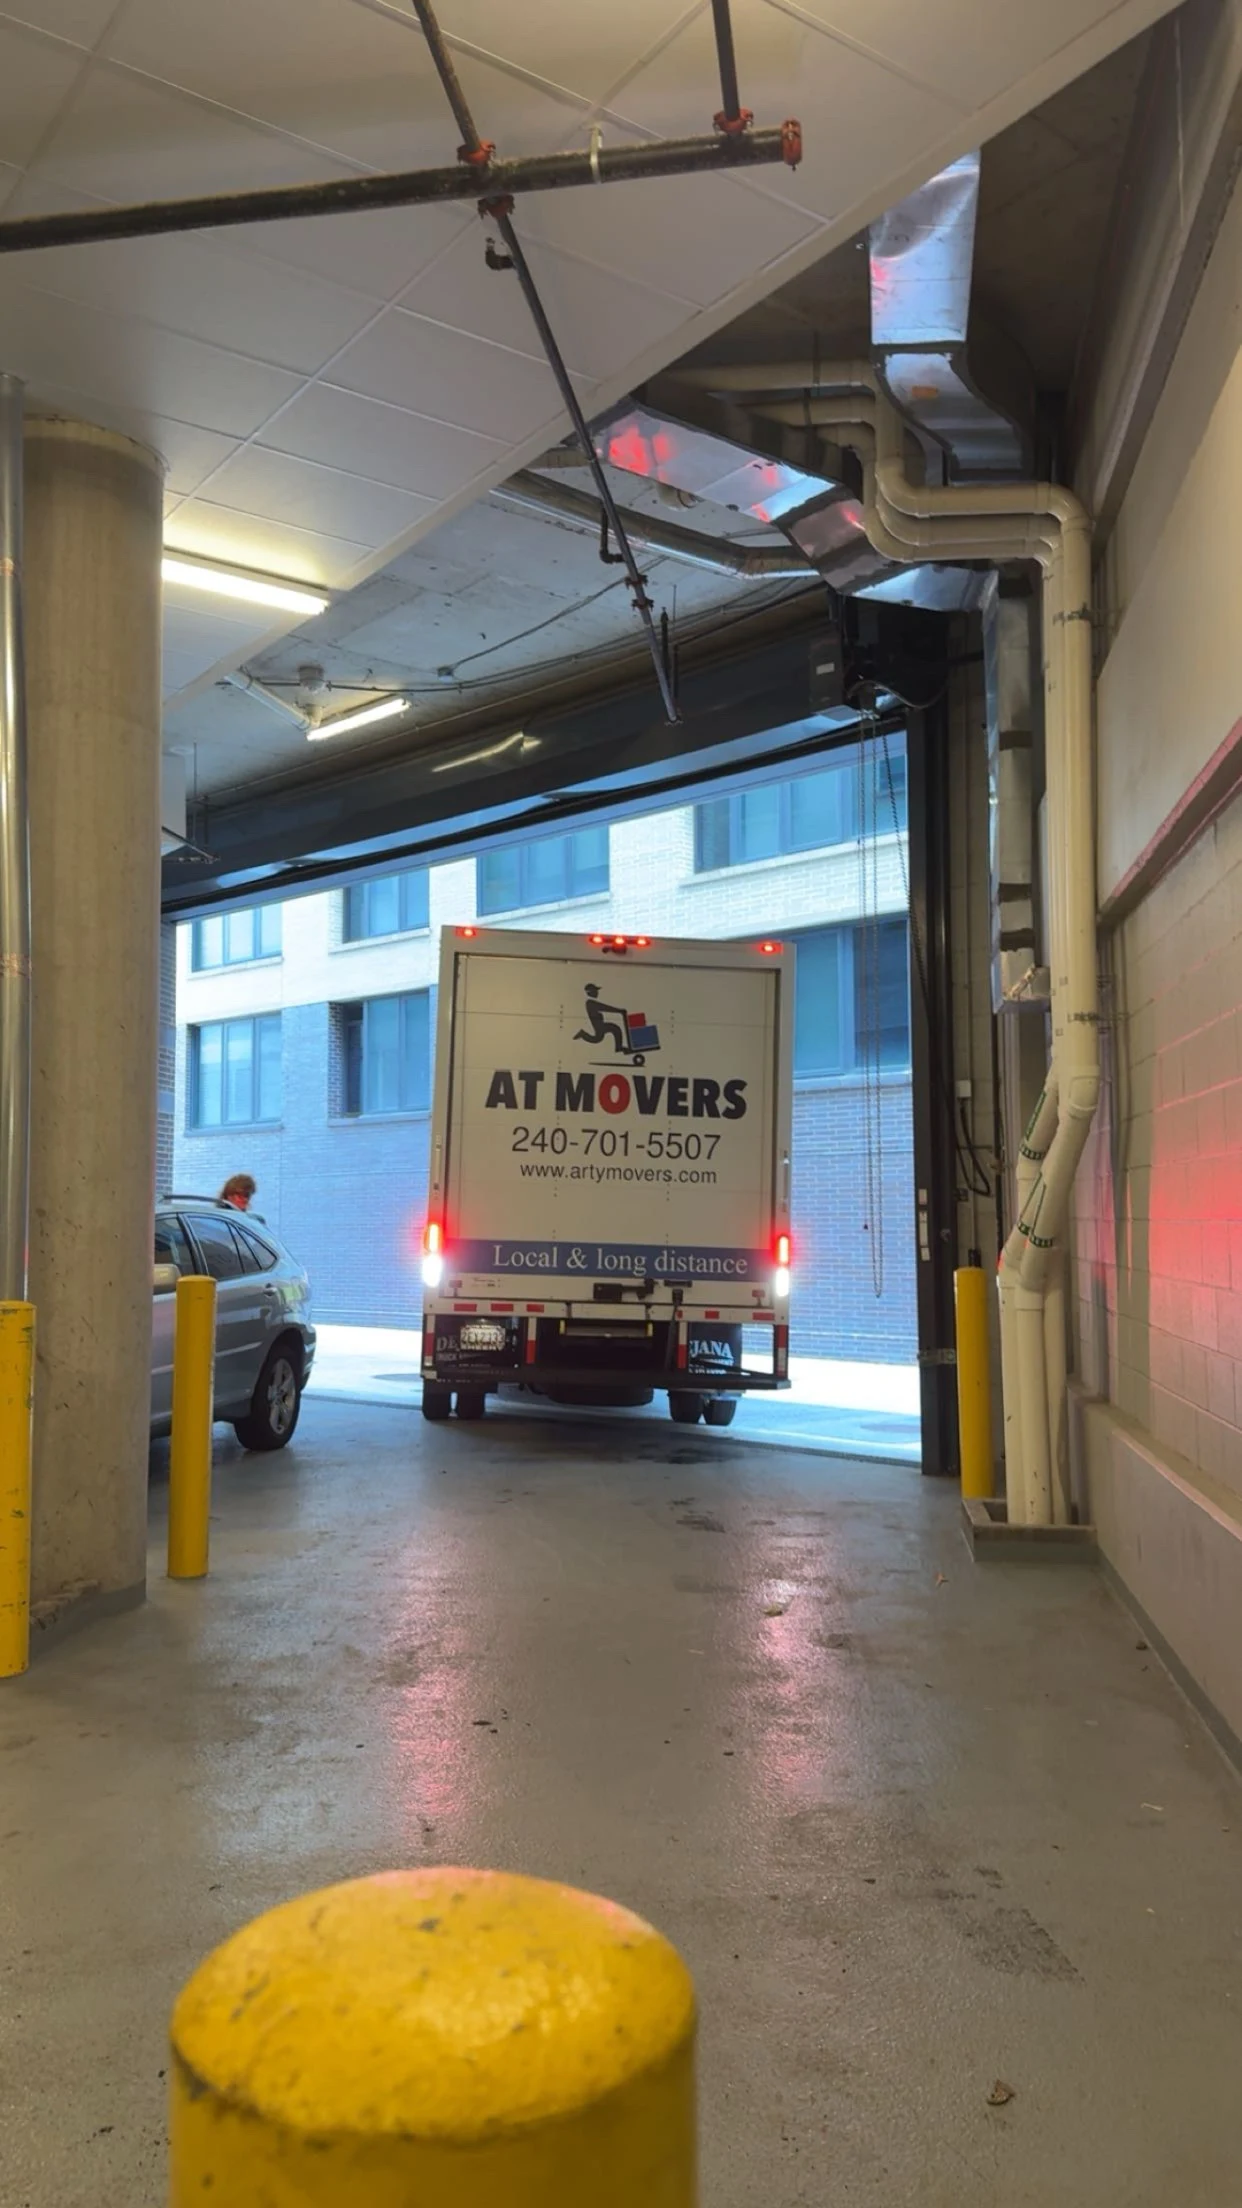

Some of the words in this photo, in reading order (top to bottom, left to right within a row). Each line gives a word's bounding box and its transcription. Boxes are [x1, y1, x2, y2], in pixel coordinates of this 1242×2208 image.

[485, 1070, 544, 1110] AT
[555, 1072, 748, 1120] MOVERS
[512, 1126, 721, 1160] 240-701-5507
[520, 1163, 717, 1183] www.artymovers.com
[492, 1245, 558, 1268] Local
[566, 1247, 588, 1269] &
[597, 1248, 646, 1276] long
[654, 1251, 748, 1274] distance
